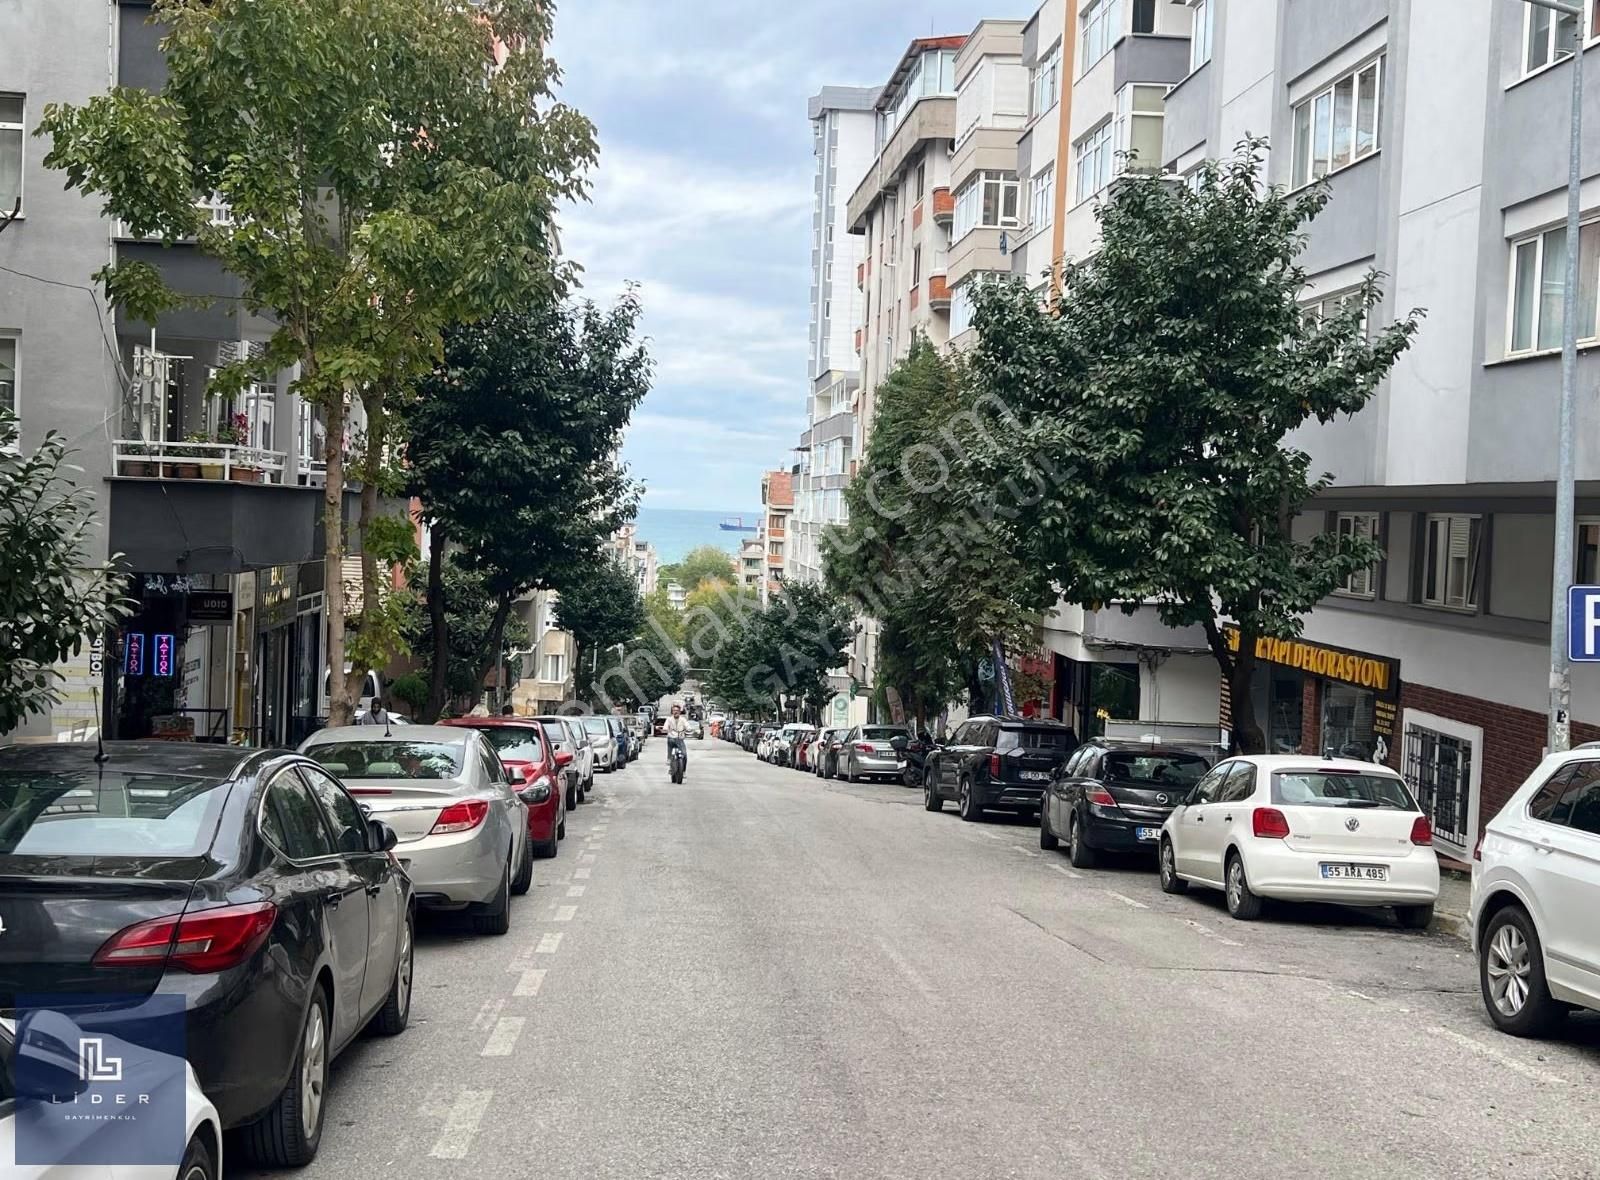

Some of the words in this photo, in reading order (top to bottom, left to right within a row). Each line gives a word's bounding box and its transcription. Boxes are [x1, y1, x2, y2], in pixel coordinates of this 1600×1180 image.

[1293, 643, 1388, 690] DEKORASYON
[1328, 866, 1341, 877] 55
[1344, 866, 1362, 878] ARA
[1365, 868, 1384, 879] 485
